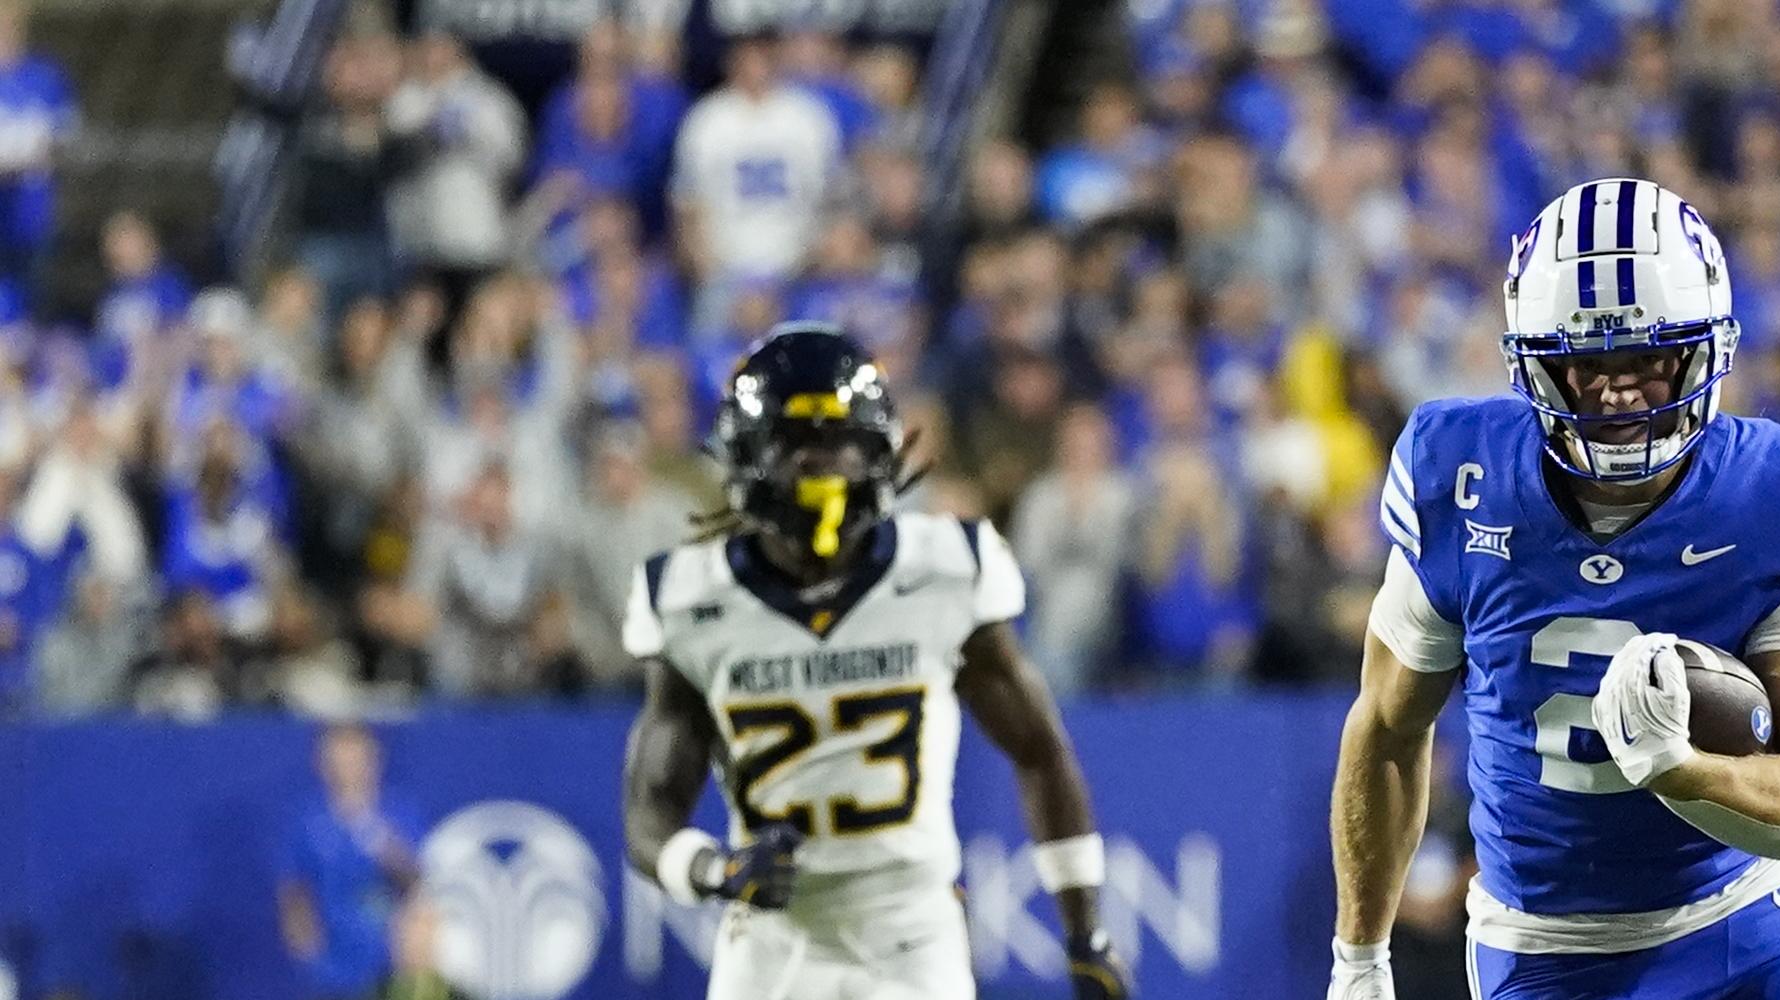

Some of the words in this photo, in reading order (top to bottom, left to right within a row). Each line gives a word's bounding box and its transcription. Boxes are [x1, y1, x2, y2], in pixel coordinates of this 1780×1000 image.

[1594, 313, 1624, 331] BYU
[1454, 462, 1485, 510] C
[1531, 617, 1654, 793] 2
[724, 684, 928, 840] 23
